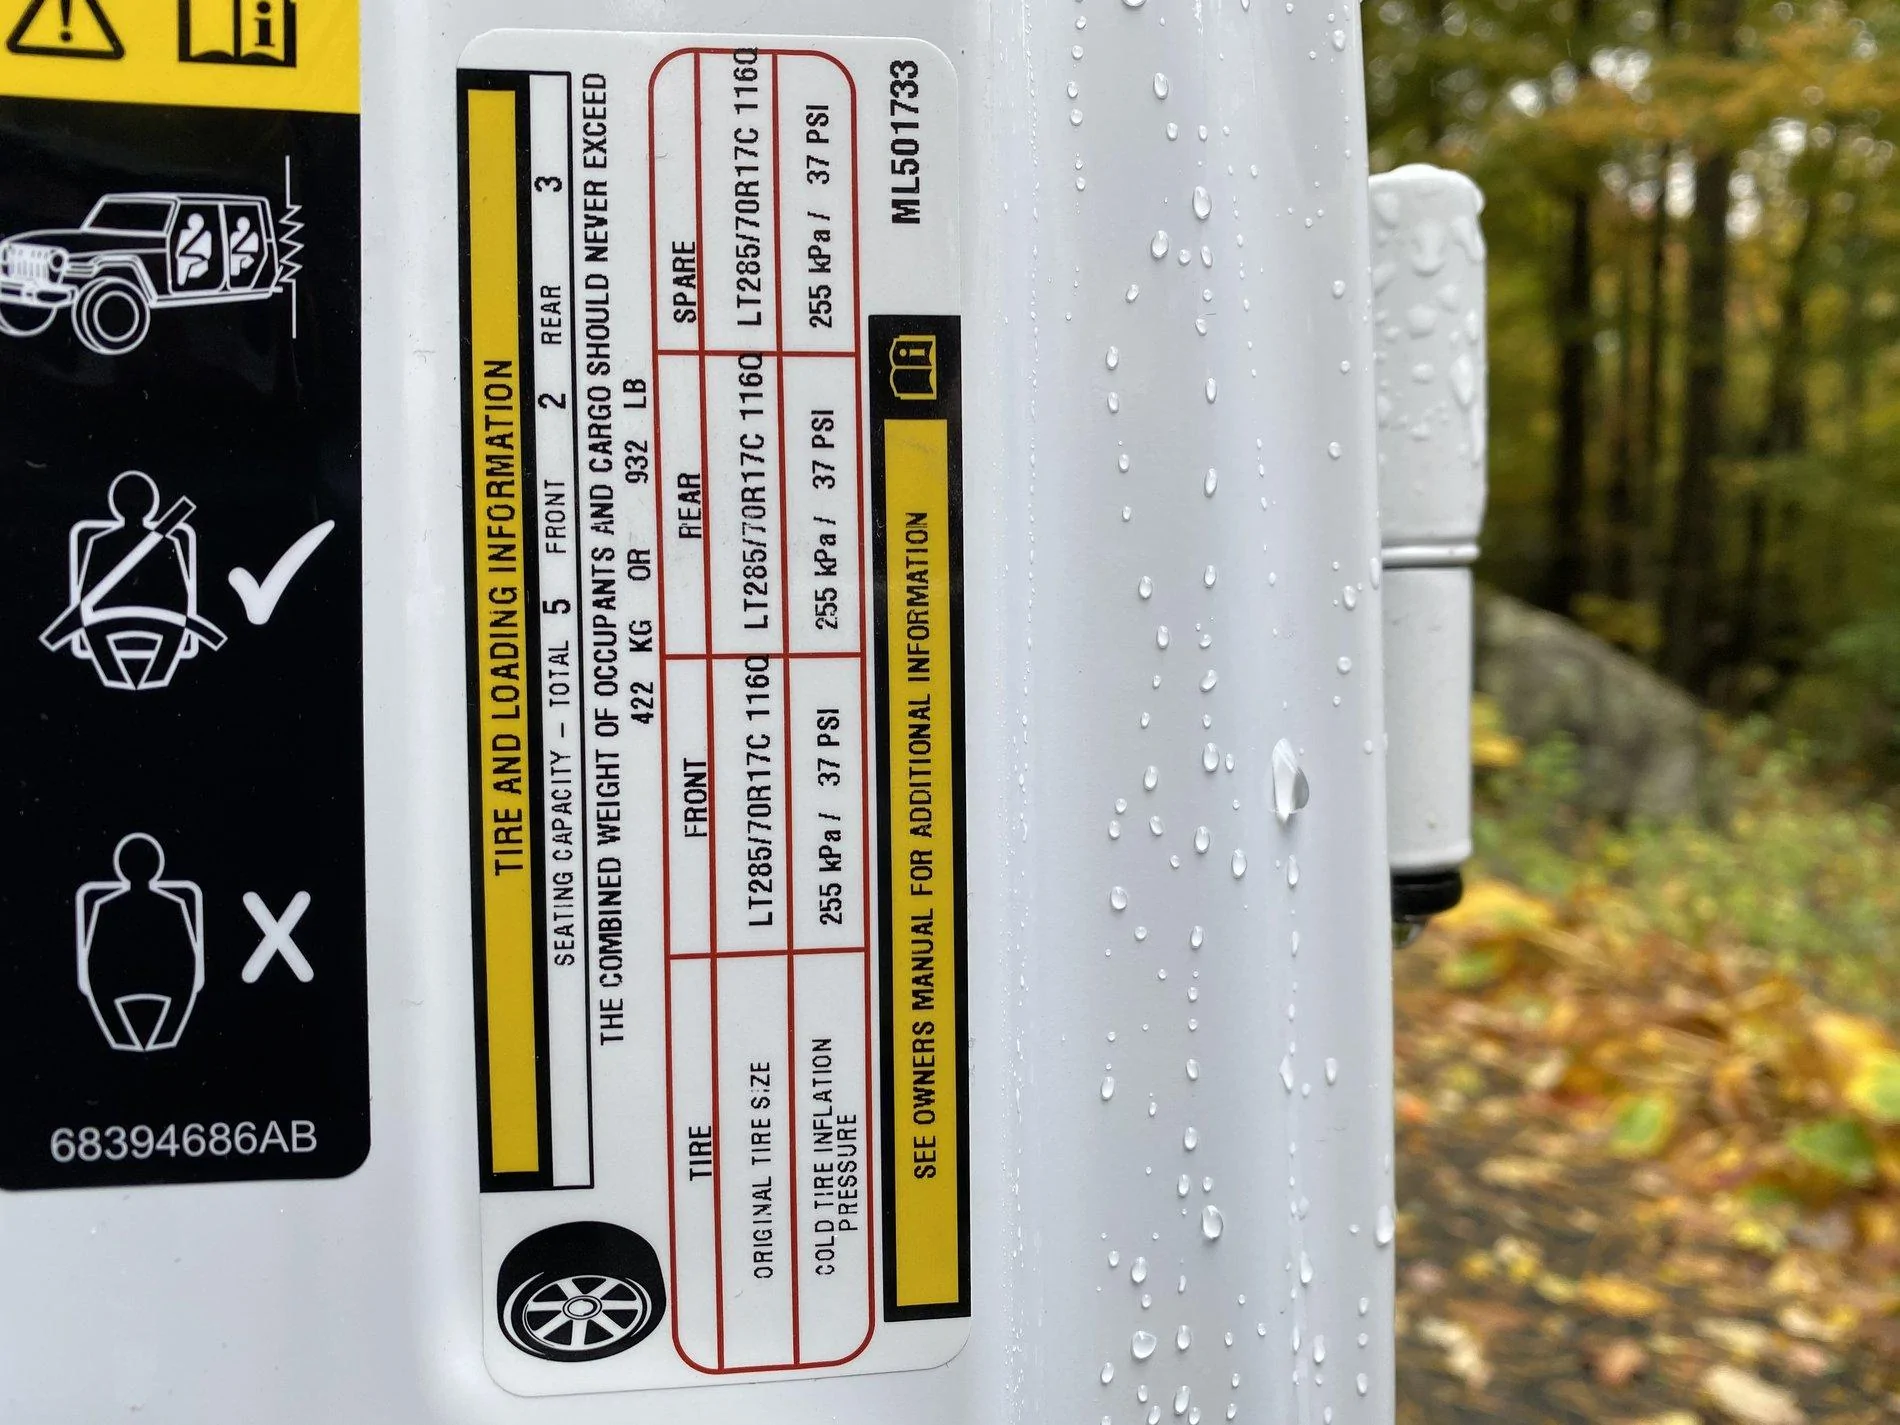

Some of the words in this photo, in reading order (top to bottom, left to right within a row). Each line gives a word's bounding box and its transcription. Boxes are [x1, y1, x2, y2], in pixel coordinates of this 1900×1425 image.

[583, 74, 606, 168] EXCEED
[806, 105, 829, 143] PSI
[890, 61, 920, 224] ML501733
[534, 177, 562, 192] 3
[807, 155, 829, 184] 37
[584, 180, 608, 261] NEVER
[734, 128, 761, 325] LT285/70R17C
[672, 242, 696, 323] SPARE
[809, 285, 832, 328] 255
[541, 286, 561, 344] REAR
[585, 274, 610, 375] SHOULD
[538, 394, 566, 409] 2
[623, 379, 646, 408] LB
[588, 387, 612, 472] CARGO
[811, 410, 834, 448] PSI
[484, 359, 520, 572] INFORMATION
[625, 441, 648, 483] 932
[812, 460, 835, 489] 37
[544, 480, 566, 553] FRONT
[590, 485, 614, 535] AND
[678, 473, 701, 538] REAR
[740, 434, 768, 628] LT285/70R17C
[627, 549, 650, 581] OR
[543, 599, 570, 614] 5
[591, 548, 618, 696] OCCUPANTS
[815, 588, 837, 629] 255
[906, 513, 930, 681] INFORMATION
[489, 587, 520, 719] LOADING
[629, 621, 652, 652] KG
[549, 641, 569, 707] TOTAL
[630, 682, 653, 724] 422
[595, 708, 618, 737] OF
[817, 709, 839, 746] PSI
[492, 734, 521, 794] AND
[818, 758, 840, 786] 37
[908, 694, 932, 838] ADDITIONAL
[550, 751, 572, 860] CAPACITY
[596, 749, 620, 845] WEIGHT
[684, 758, 707, 837] FRONT
[494, 809, 523, 876] TIRE
[746, 734, 772, 926] LT285/70R17C
[910, 850, 932, 895] FOR
[553, 872, 574, 965] SEATING
[598, 858, 622, 987] COMBINED
[819, 883, 842, 925] 255
[911, 909, 934, 1010] MANUAL
[600, 999, 623, 1045] THE
[812, 1039, 833, 1152] INFLATION
[912, 1021, 935, 1124] OWNERS
[50, 1119, 318, 1163] 68394686AB
[689, 1126, 712, 1181] TIRE
[751, 1119, 771, 1165] TIRE
[914, 1136, 936, 1179] SEE
[814, 1163, 833, 1209] TIRE
[837, 1115, 857, 1231] PRESSURE
[752, 1176, 773, 1278] ORIGINAL
[815, 1220, 834, 1275] COLD
